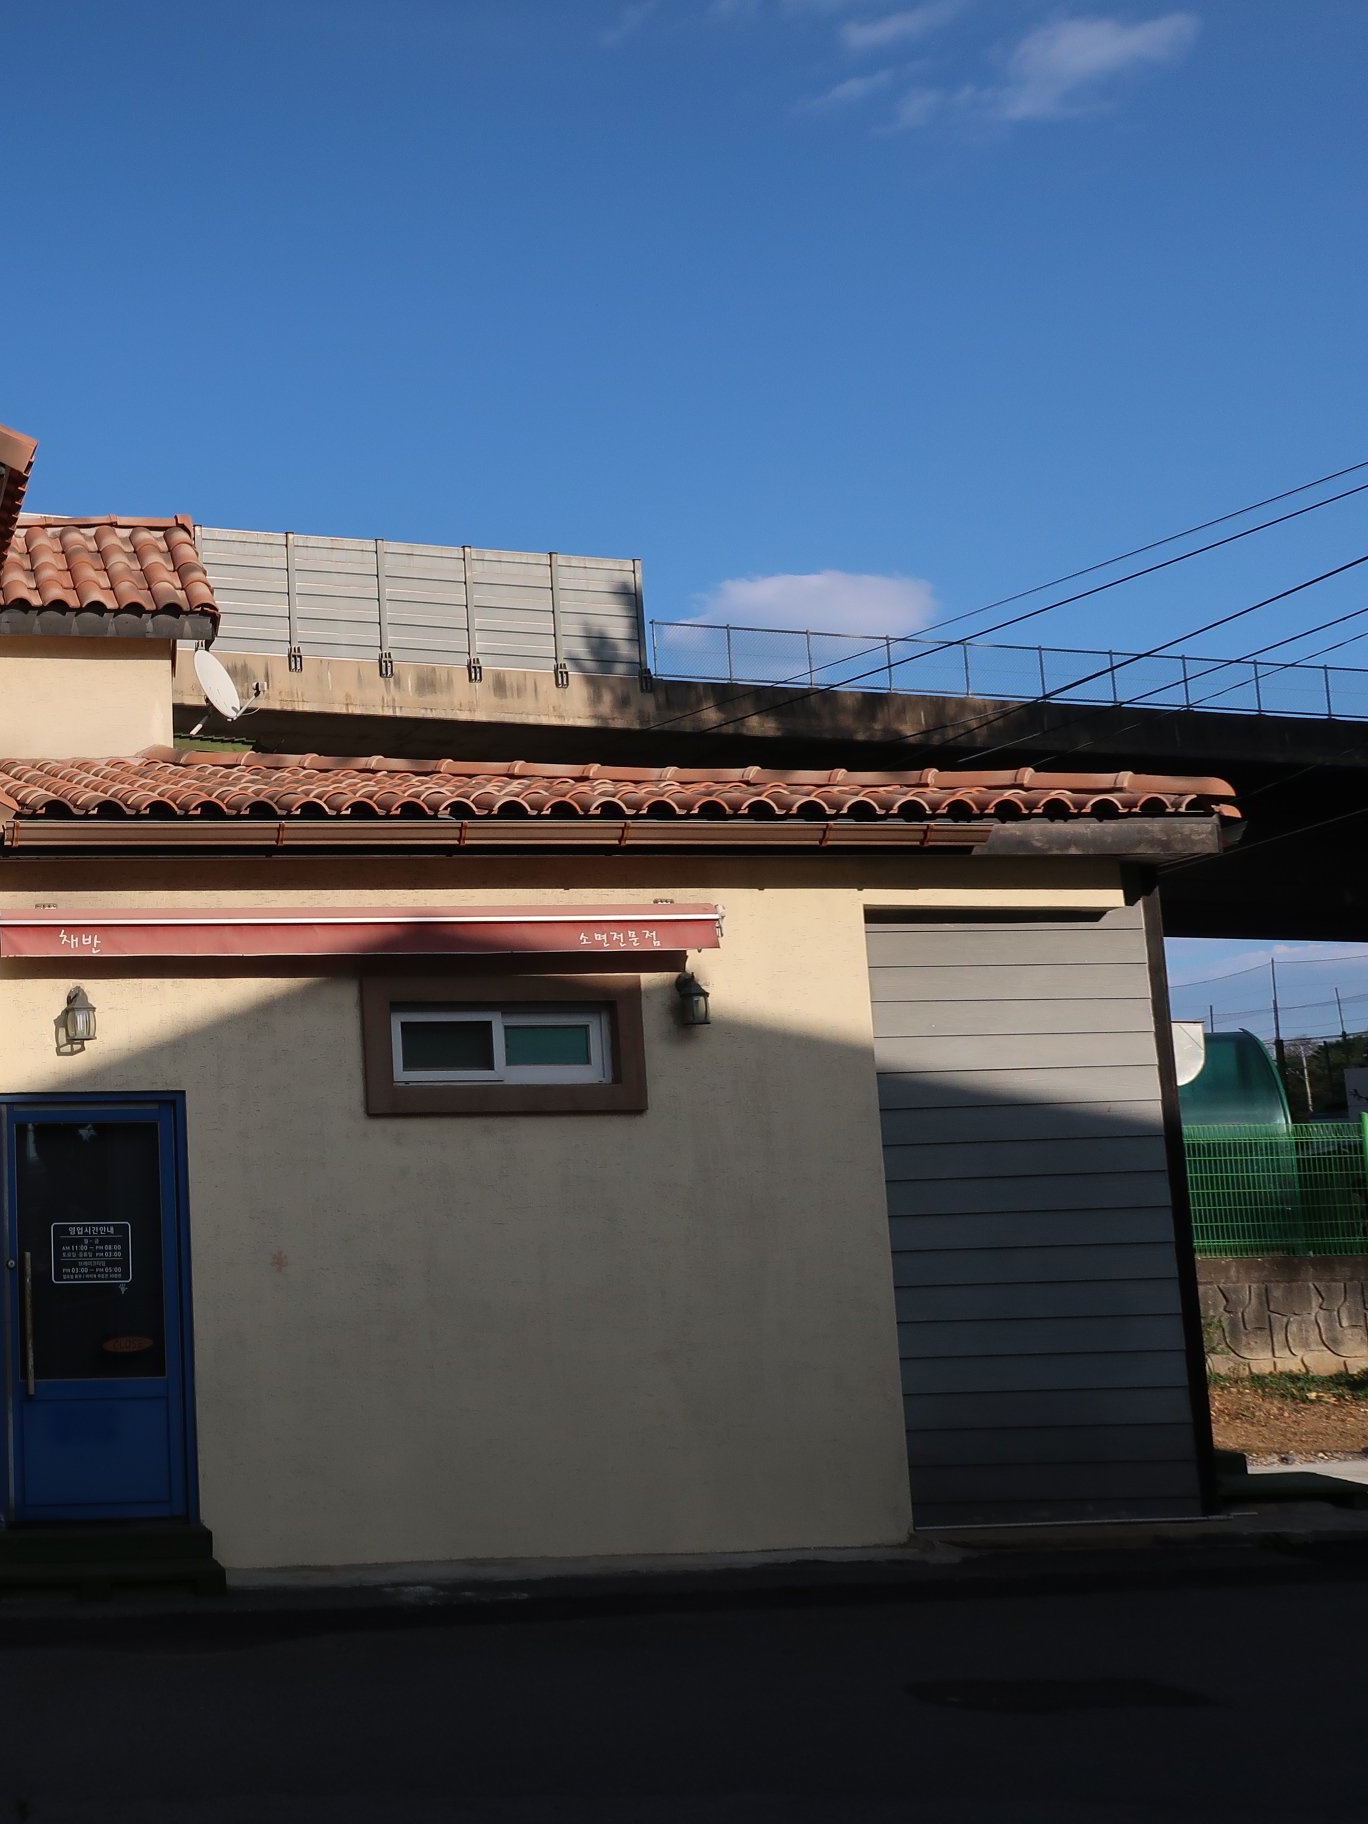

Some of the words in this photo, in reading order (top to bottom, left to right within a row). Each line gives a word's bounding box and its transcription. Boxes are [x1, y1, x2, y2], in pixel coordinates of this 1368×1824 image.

[58, 929, 102, 954] 채반
[579, 929, 662, 947] 소면전문점
[68, 1226, 115, 1235] 영업시간안내
[113, 1338, 143, 1350] CLOSE
